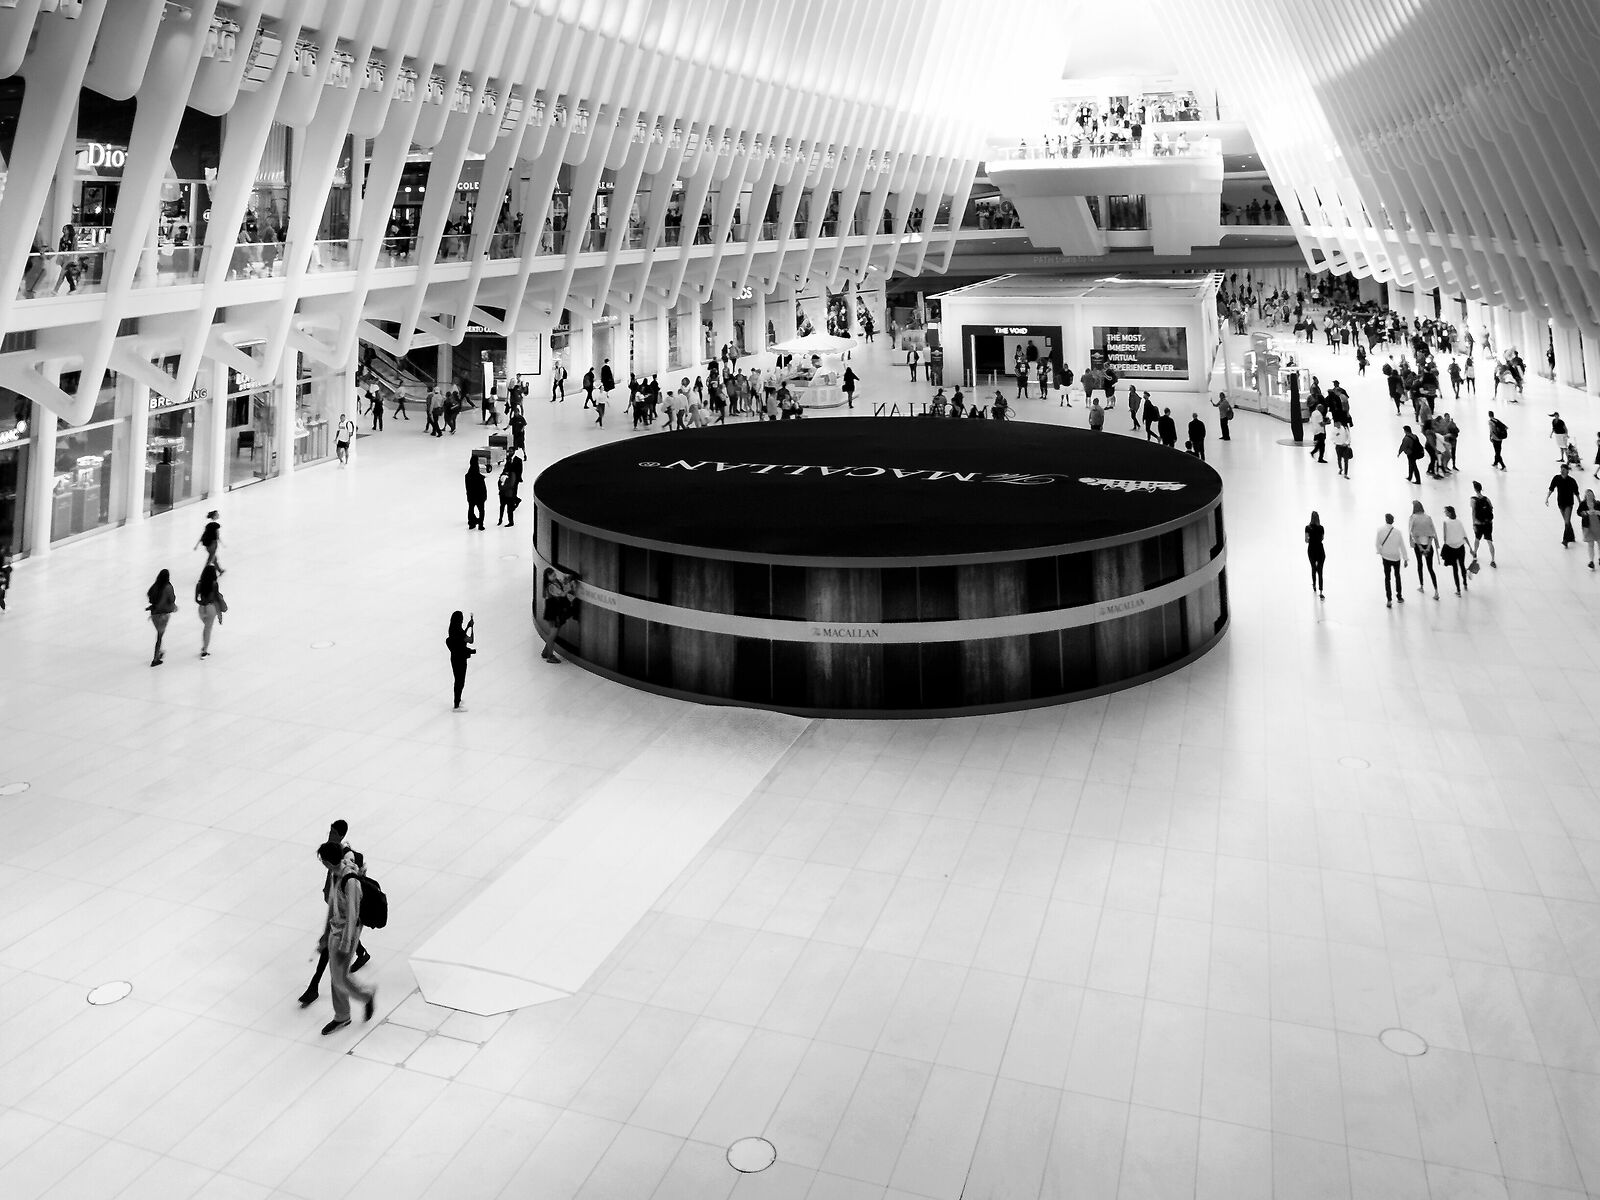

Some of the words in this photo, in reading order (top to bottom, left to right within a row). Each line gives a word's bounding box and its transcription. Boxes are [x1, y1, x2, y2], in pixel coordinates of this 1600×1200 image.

[88, 142, 129, 168] Dio
[457, 181, 480, 190] COLE
[1009, 327, 1028, 335] VOID
[1107, 344, 1147, 352] IMMERSIVE
[1108, 354, 1138, 362] VIRTUAL
[1106, 599, 1145, 614] MACALLAN
[823, 628, 879, 638] MACALLAN
